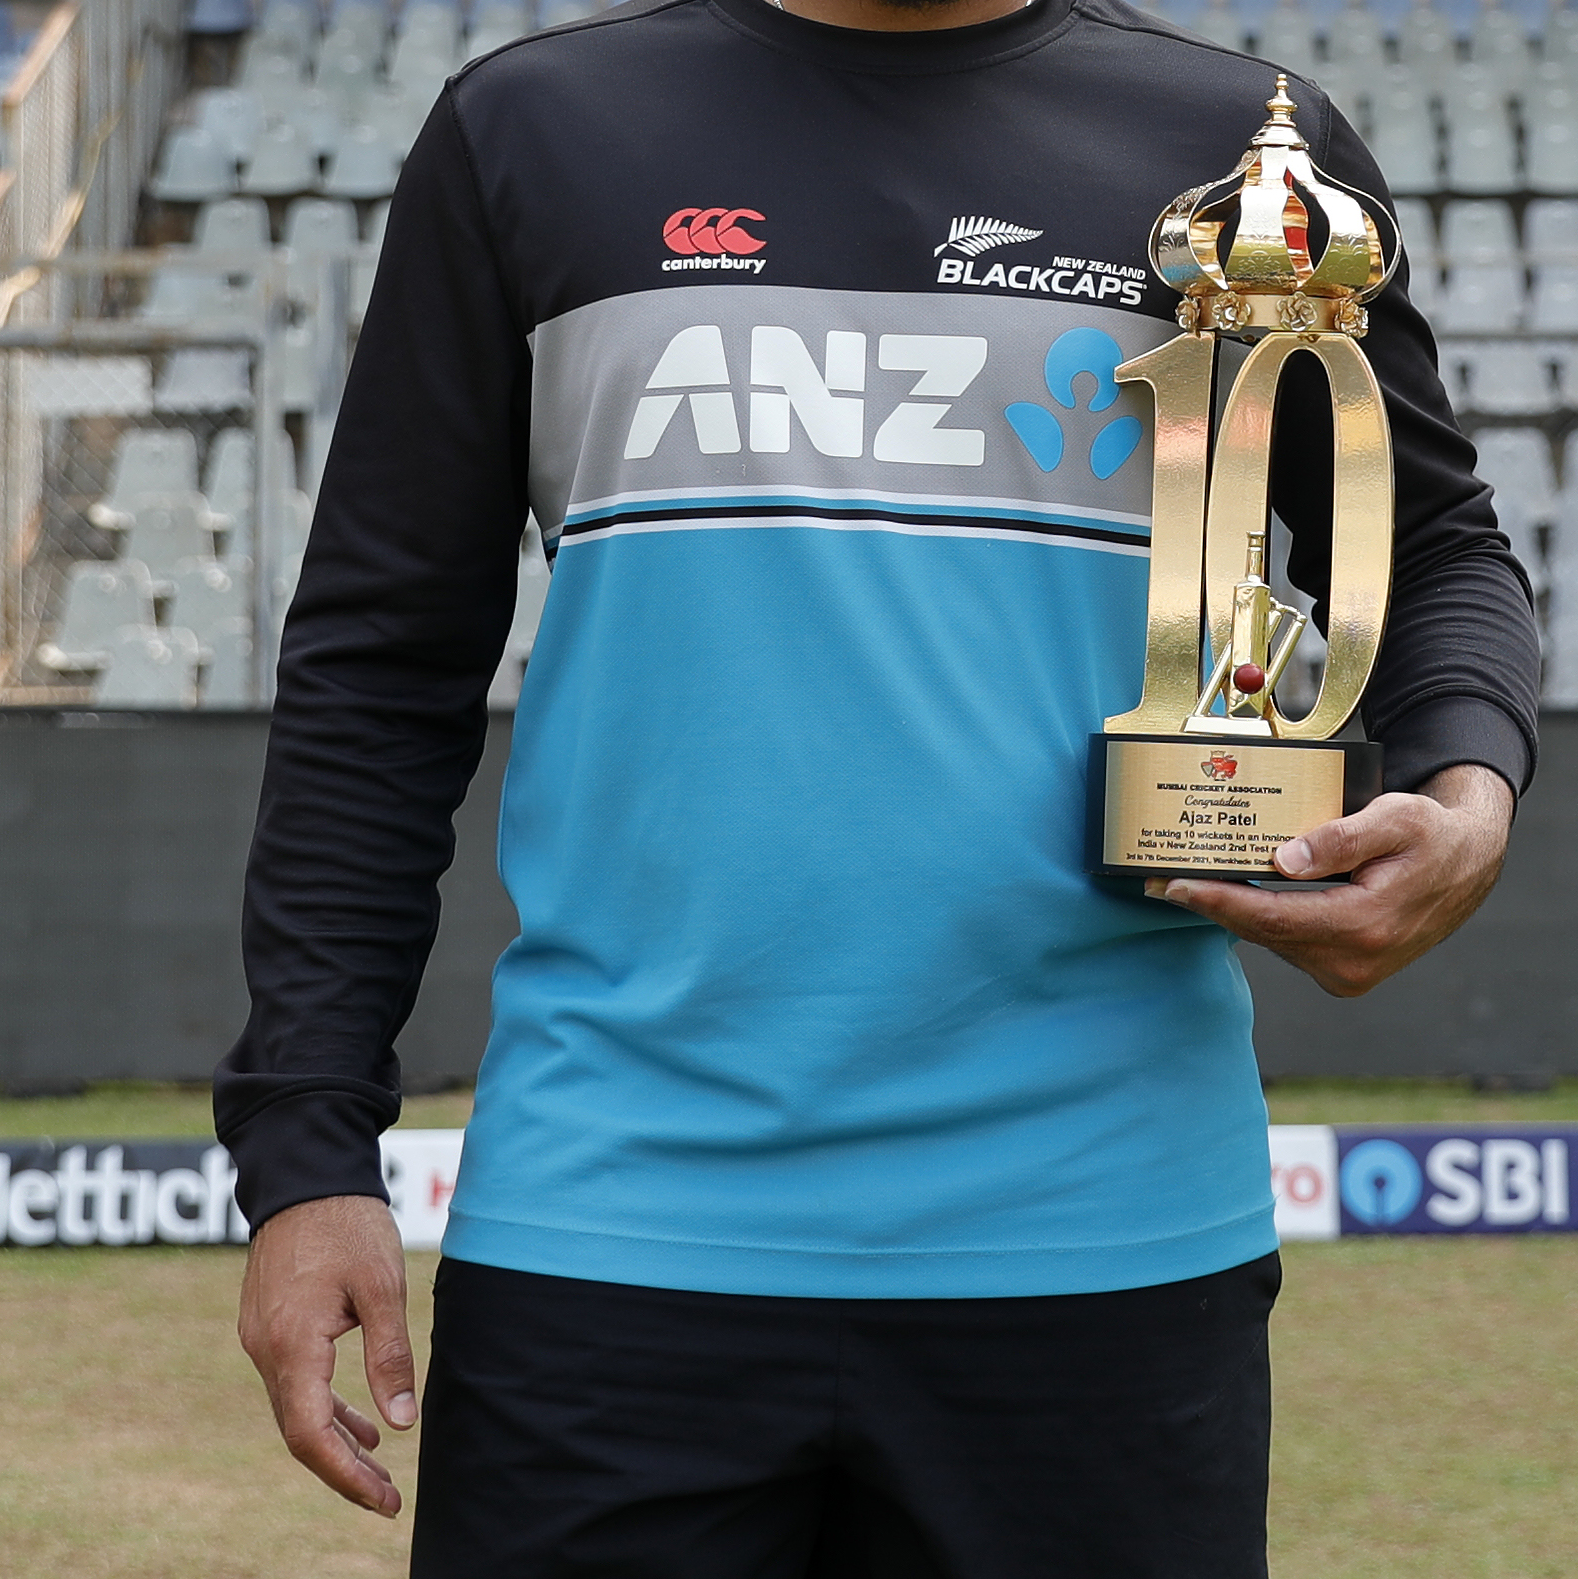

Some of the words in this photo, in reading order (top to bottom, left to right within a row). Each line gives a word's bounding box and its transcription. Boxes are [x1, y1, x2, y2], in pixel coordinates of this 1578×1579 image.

[661, 253, 767, 275] canterbury
[1052, 256, 1086, 271] NEW
[1086, 260, 1147, 281] ZEALAND
[936, 258, 1144, 307] BLACKCAPS
[623, 324, 989, 467] ANZ
[1156, 782, 1188, 792] MUMBAI
[1189, 784, 1225, 794] CRICKET
[1226, 785, 1283, 795] ASSOCIATION
[1178, 810, 1213, 827] Ajaz
[1217, 811, 1257, 827] Patel
[1140, 827, 1153, 837] for
[1154, 828, 1182, 840] taking
[1184, 829, 1196, 839] 10
[1197, 830, 1233, 841] wickets
[1236, 832, 1245, 841] in
[1247, 833, 1260, 842] an
[1137, 839, 1158, 849] India
[1159, 841, 1165, 849] v
[1166, 840, 1188, 850] New
[1188, 840, 1227, 852] Zealand
[1227, 842, 1247, 853] 2nd
[1250, 843, 1270, 854] Test
[1155, 854, 1192, 864] December
[1424, 1137, 1570, 1227] SBI
